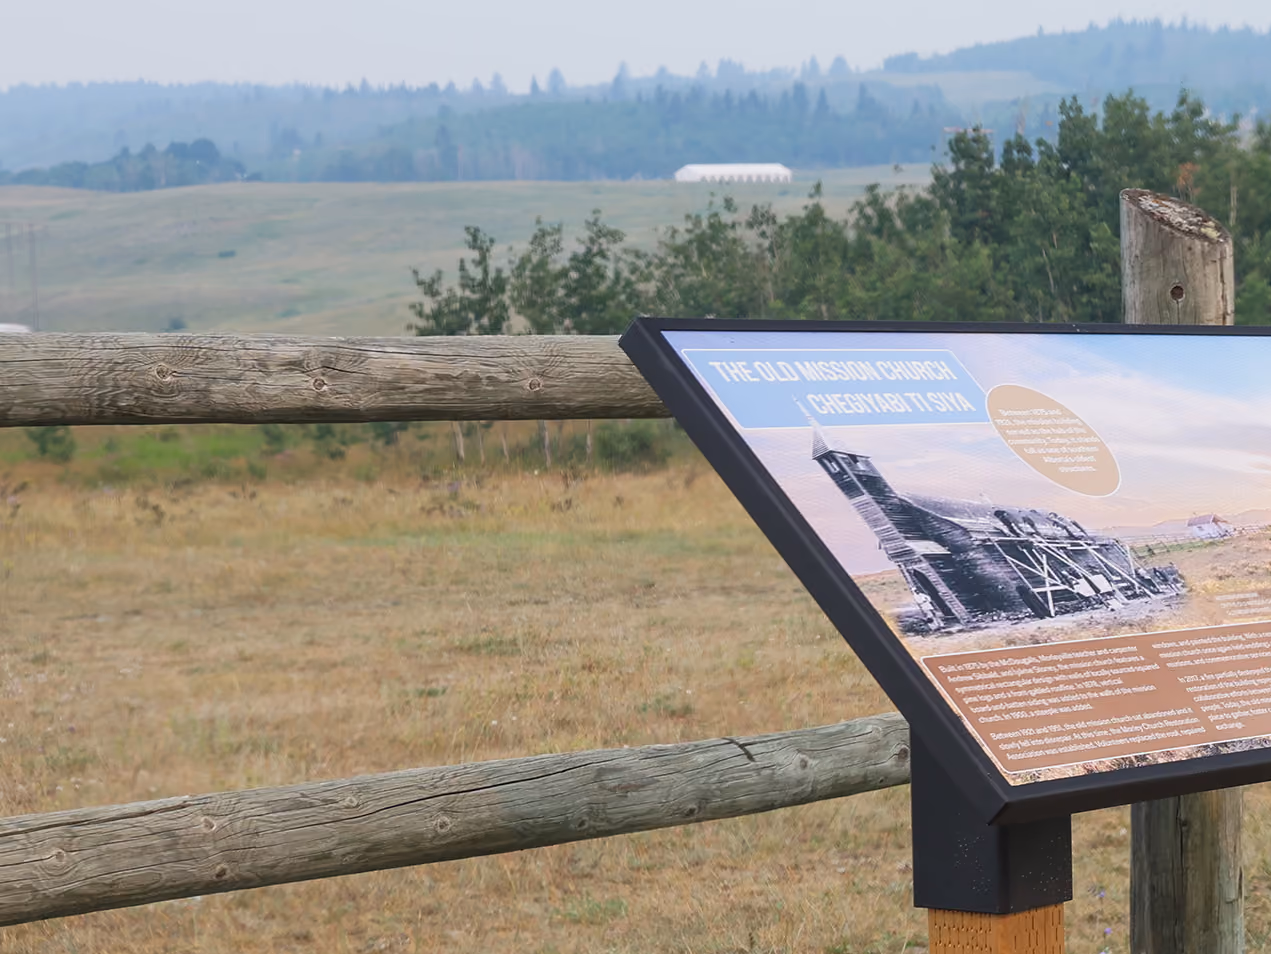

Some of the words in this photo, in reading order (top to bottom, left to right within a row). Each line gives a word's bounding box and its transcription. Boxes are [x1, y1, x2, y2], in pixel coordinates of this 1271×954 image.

[709, 361, 760, 382] THE
[753, 361, 800, 382] OLD
[794, 361, 883, 381] MISSION
[876, 361, 958, 381] CHURCH
[807, 393, 912, 414] CHEGIYABI
[904, 392, 933, 412] TI
[927, 392, 976, 412] SIYA
